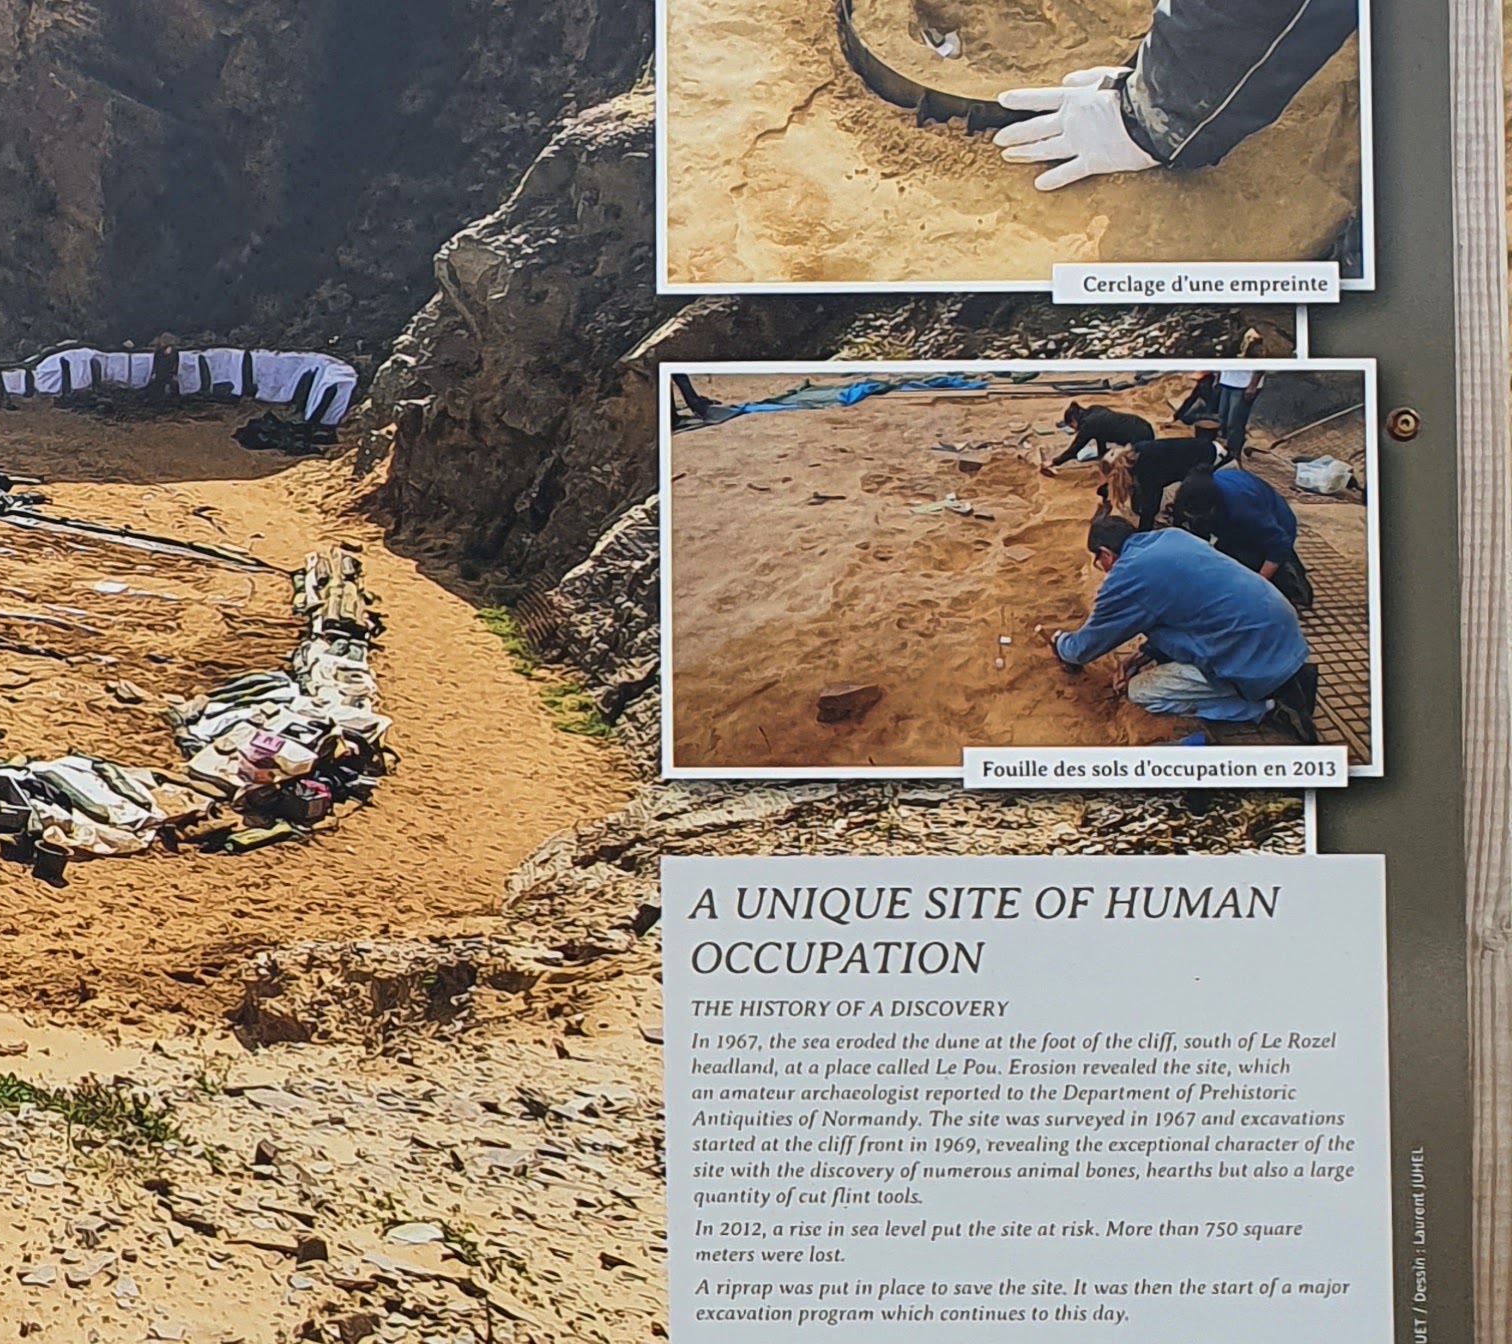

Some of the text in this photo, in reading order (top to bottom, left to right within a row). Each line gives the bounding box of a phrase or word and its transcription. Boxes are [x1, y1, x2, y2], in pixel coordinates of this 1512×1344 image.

[1083, 275, 1328, 296] Cerclage d'une empreinte
[983, 759, 1336, 781] Fouille des sols d'occupation en 2013
[687, 886, 1281, 925] A UNIQUE SITE OF HUMAN
[691, 941, 985, 974] OCCUPATION
[691, 1000, 1009, 1017] THE HISTORY OF A DISCOVERY
[696, 1244, 844, 1262] meters were lost.
